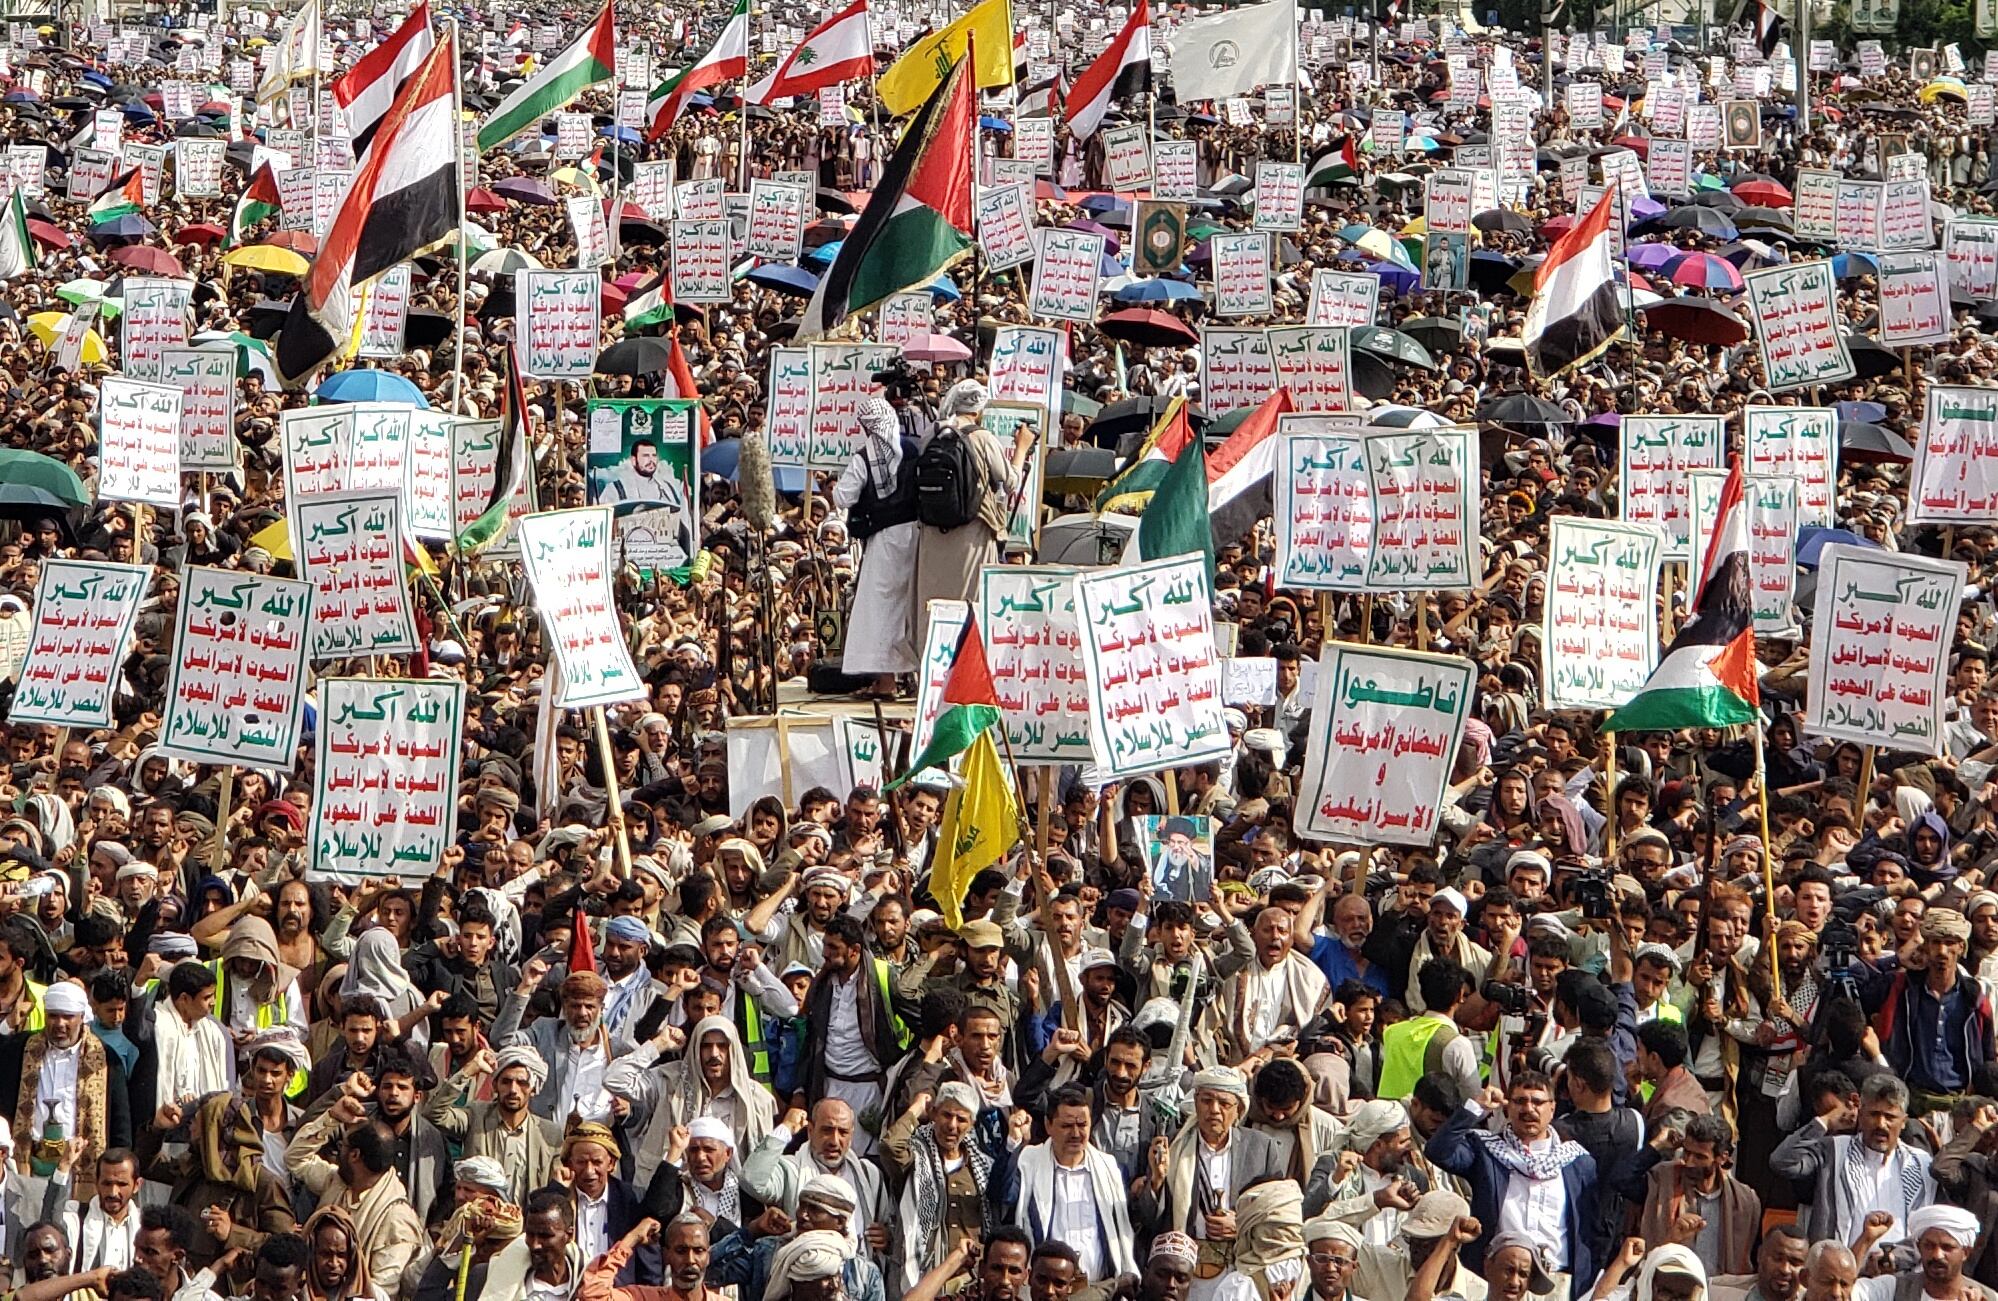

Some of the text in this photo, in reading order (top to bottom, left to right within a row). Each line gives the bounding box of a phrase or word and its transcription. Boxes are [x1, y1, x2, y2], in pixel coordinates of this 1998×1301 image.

[1938, 394, 1998, 426] طعوا
[191, 576, 305, 618] الله أكبر
[1094, 571, 1205, 628] الله أكبر
[188, 614, 298, 651] الموت لأمريكا
[1098, 613, 1209, 653] الموت لأمريكا
[183, 647, 294, 683] الموت لإسرائيل
[1103, 656, 1163, 690] لإسرائيل
[1167, 646, 1215, 674] الموت
[179, 681, 290, 714] اللعنة على اليهود
[330, 685, 451, 729] الله أكبر
[1107, 692, 1149, 723] اليهود
[1155, 688, 1179, 715] على
[1185, 679, 1217, 703] اللعنة
[1342, 668, 1458, 714] قاطعوا
[172, 708, 287, 749] النصر للإسلام
[331, 730, 447, 761] الموت لأمريكا
[1115, 708, 1228, 764] النصر للإسلام
[1335, 719, 1448, 759] البضائع الأمريكية
[328, 766, 445, 795] الموت لإسرائيل
[1375, 762, 1387, 785] و
[324, 800, 443, 827] اللعنة على اليهود
[1320, 792, 1435, 833] الإسرائيلية
[320, 831, 440, 868] النصر للإسلام
